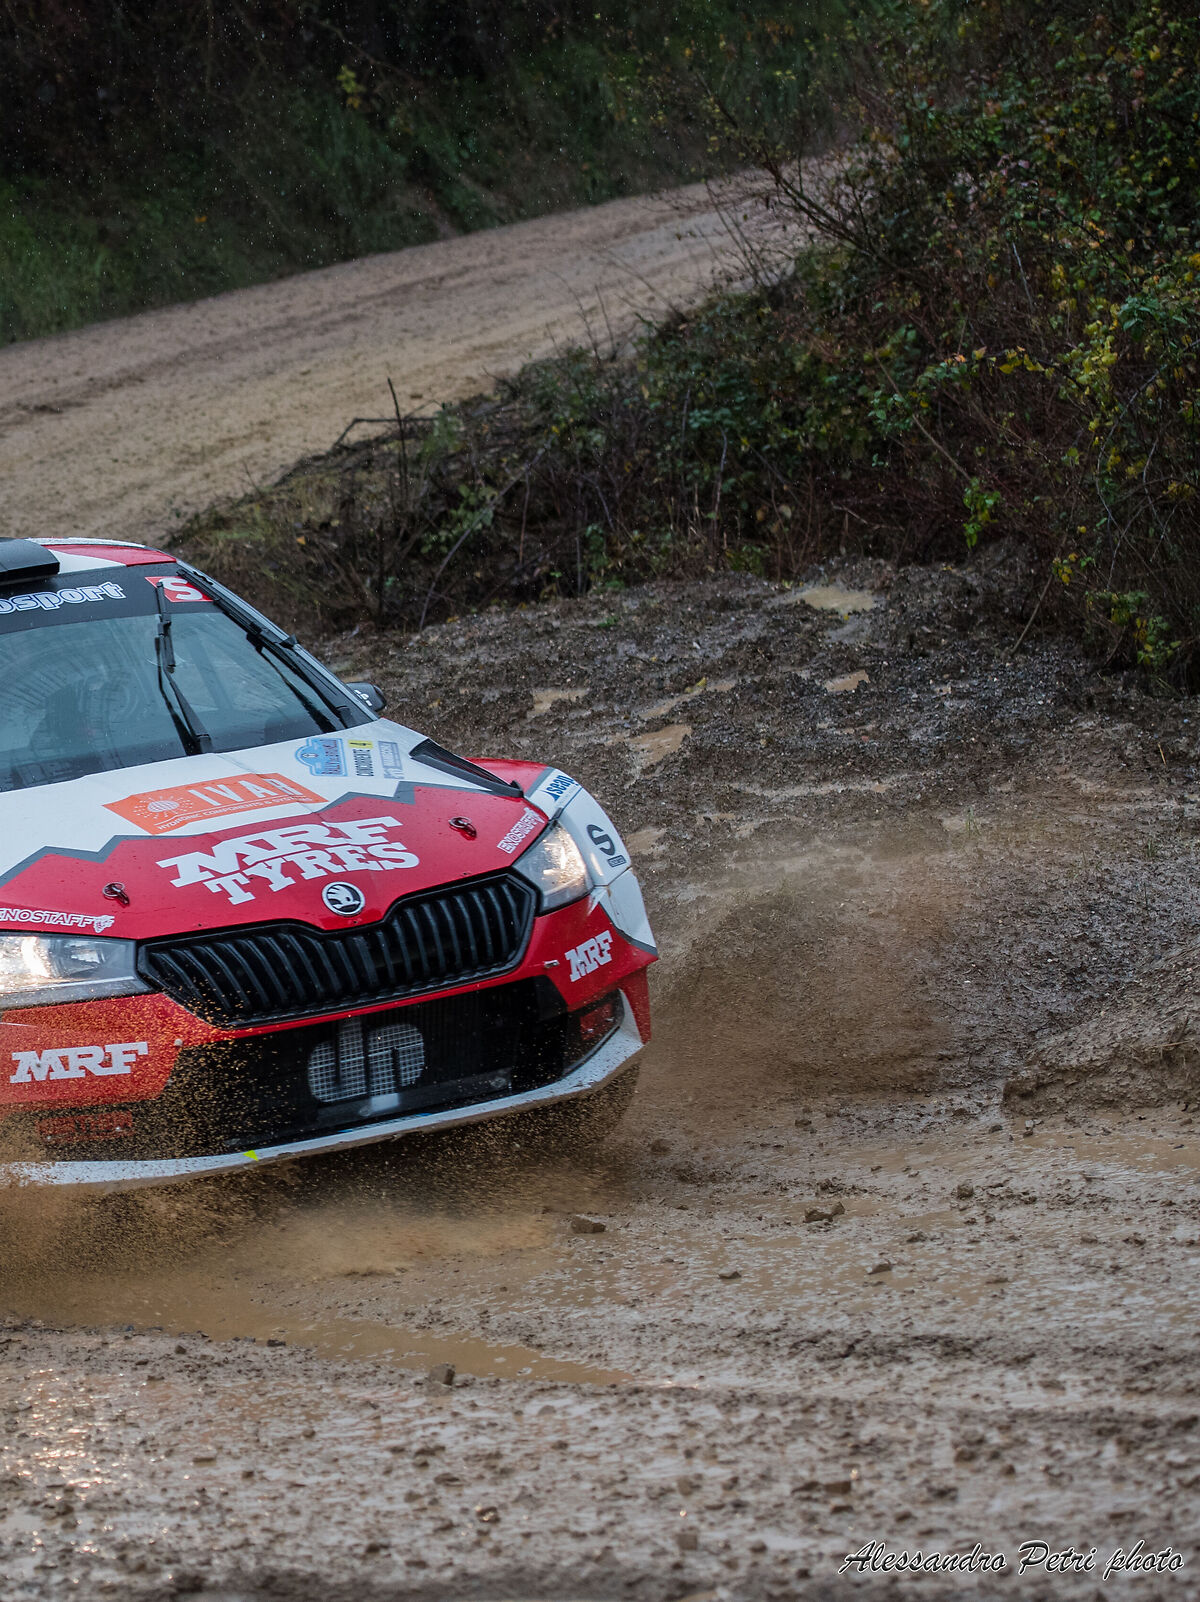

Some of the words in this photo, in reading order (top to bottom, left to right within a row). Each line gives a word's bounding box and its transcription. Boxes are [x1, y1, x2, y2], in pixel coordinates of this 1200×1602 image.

[187, 778, 304, 807] IVAR
[545, 774, 580, 795] seap
[155, 816, 404, 888] MRF
[202, 842, 420, 905] TYRES
[564, 929, 614, 983] MRF
[9, 1041, 148, 1084] MRF
